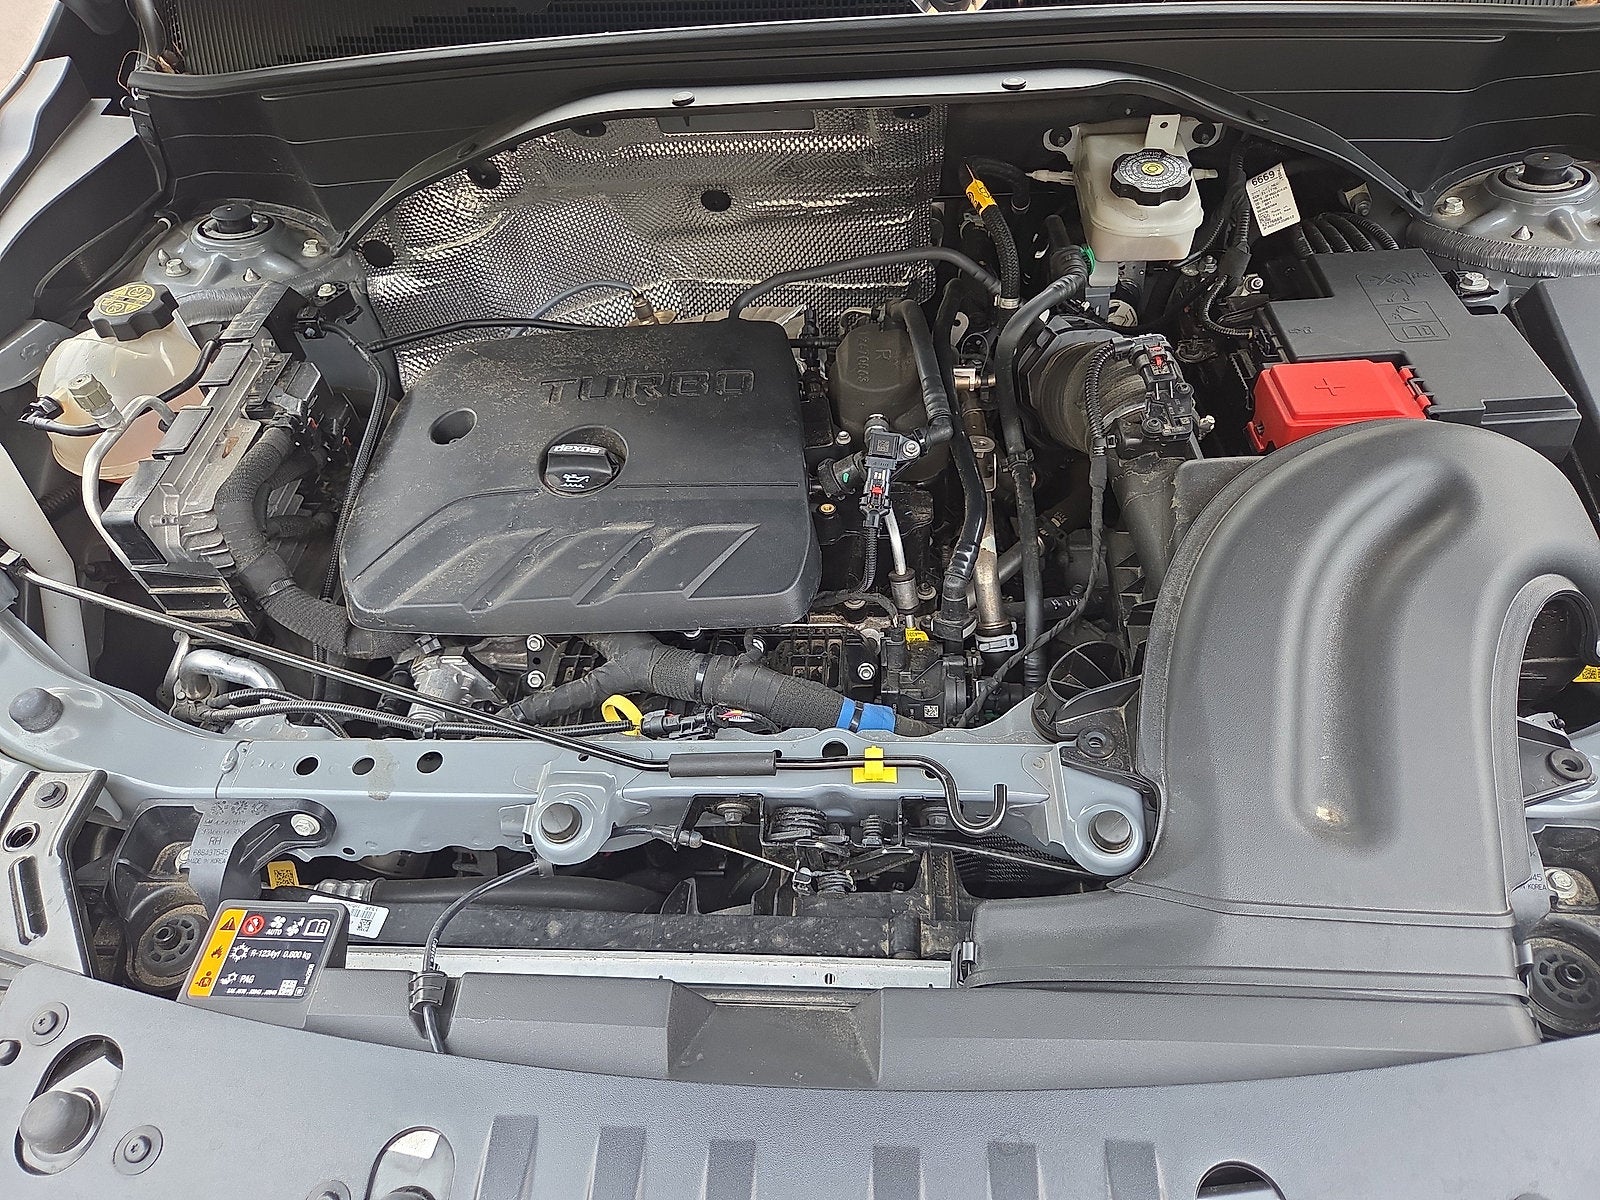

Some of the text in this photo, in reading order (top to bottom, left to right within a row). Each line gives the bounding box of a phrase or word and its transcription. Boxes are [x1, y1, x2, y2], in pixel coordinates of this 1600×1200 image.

[1251, 170, 1275, 186] 6669
[541, 369, 755, 404] TURBO
[553, 443, 601, 454] dexos
[208, 836, 222, 845] RH
[265, 928, 283, 936] AUTO
[249, 949, 281, 960] R-1234yf
[302, 950, 312, 960] kg
[239, 974, 256, 984] PAG
